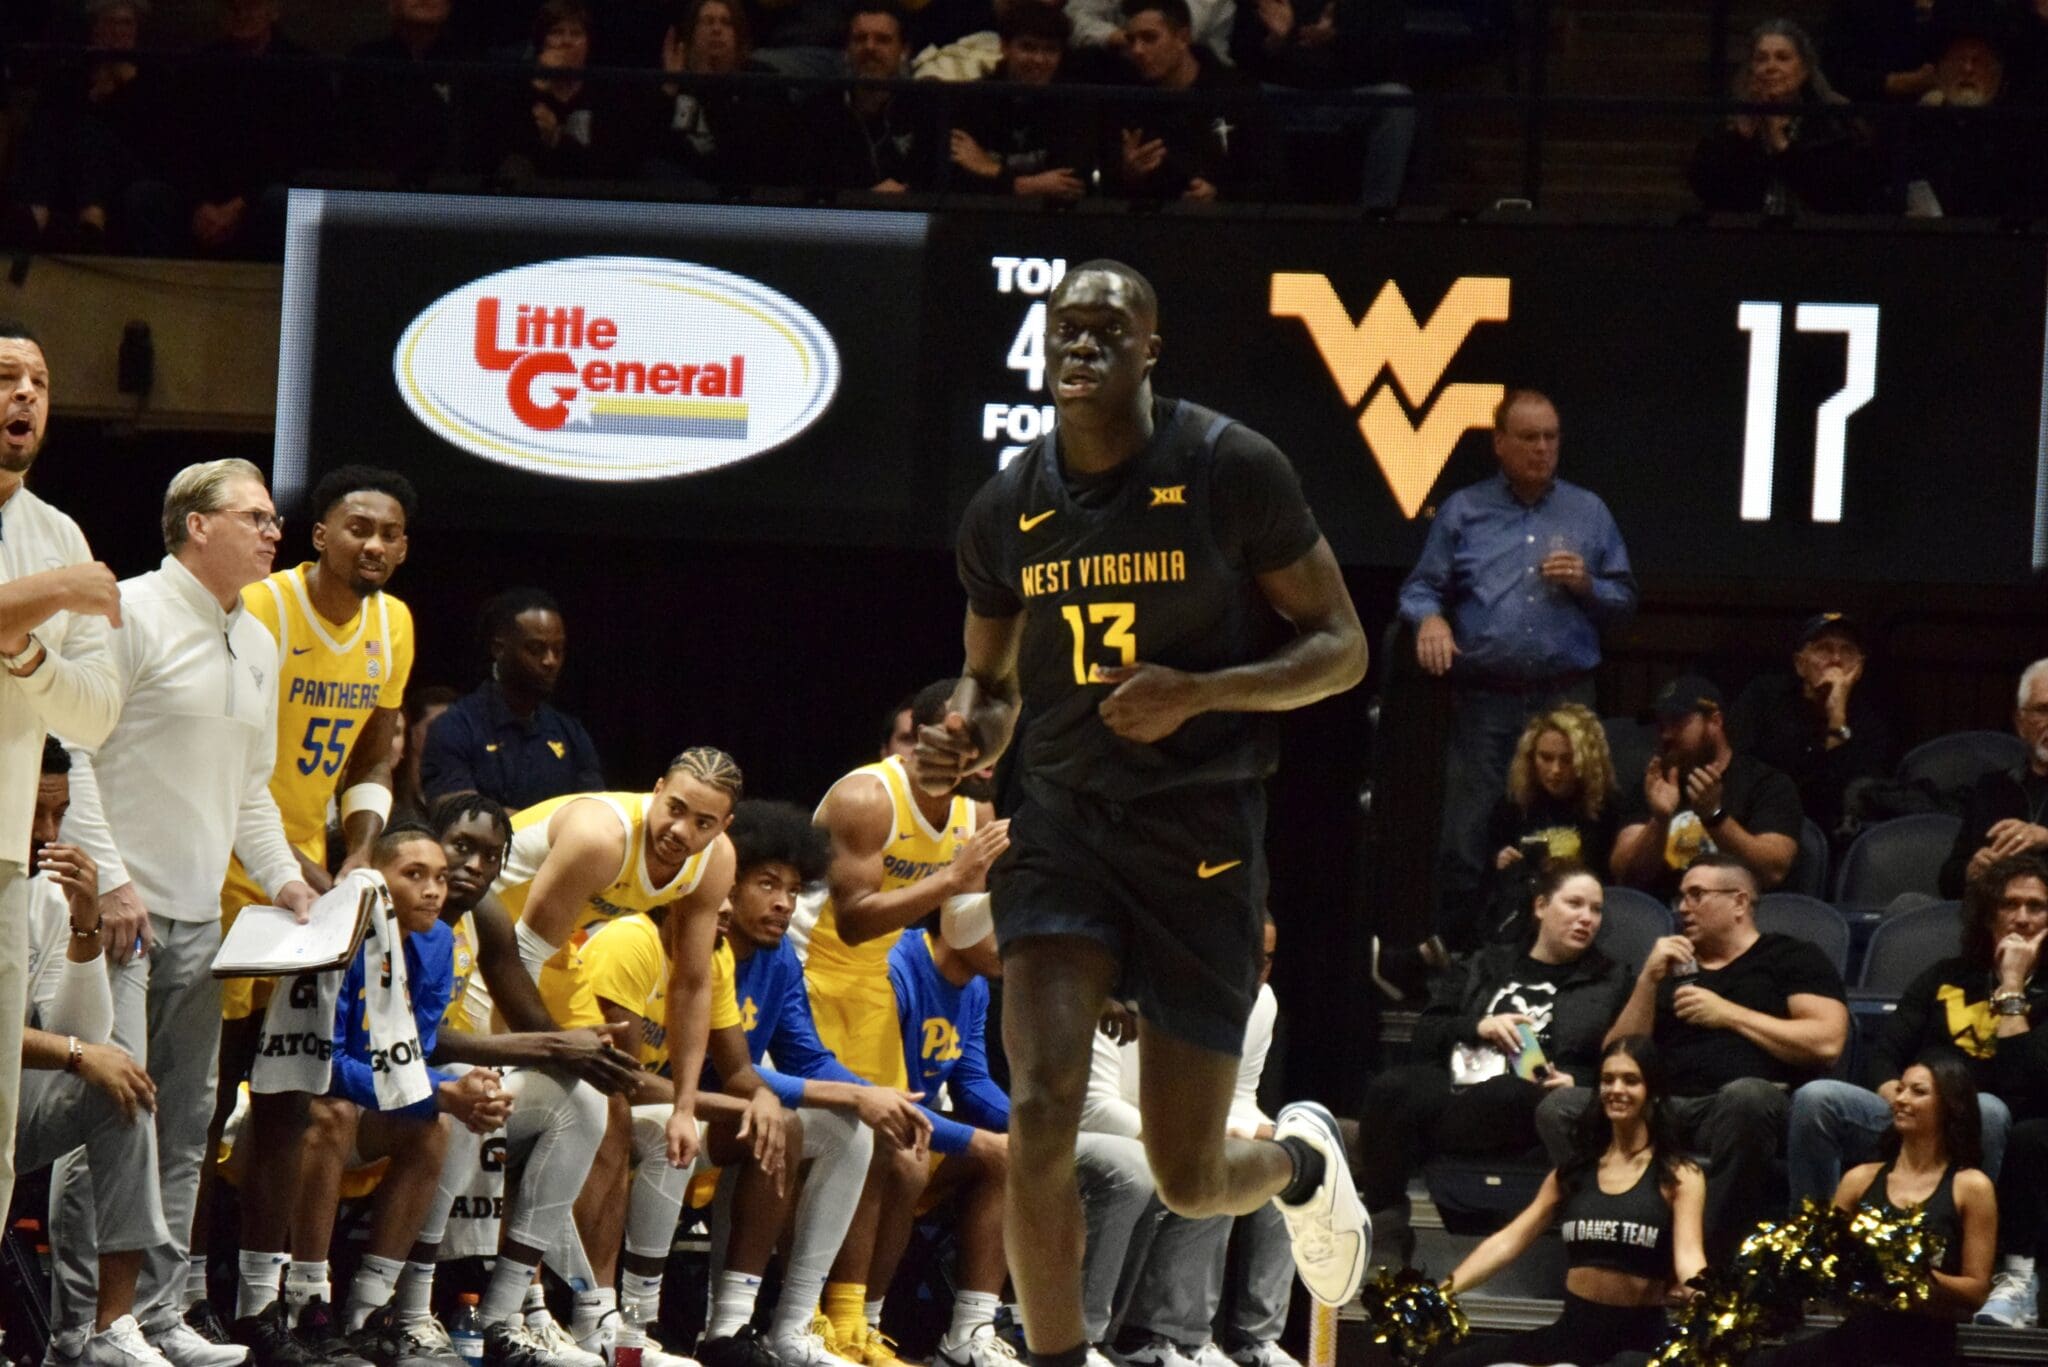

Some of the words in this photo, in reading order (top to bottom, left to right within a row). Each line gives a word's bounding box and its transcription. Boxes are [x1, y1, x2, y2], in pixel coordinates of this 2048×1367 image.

[474, 297, 617, 370] Little
[1007, 301, 1047, 391] 4
[507, 352, 745, 430] General
[1737, 301, 1879, 523] 17
[1022, 561, 1071, 597] WEST
[1079, 550, 1185, 587] VIRGINIA
[1061, 602, 1136, 685] 13
[288, 677, 380, 710] PANTHERS
[297, 717, 354, 776] 55
[1577, 1219, 1619, 1241] DANCE
[1622, 1221, 1659, 1248] TEAM
